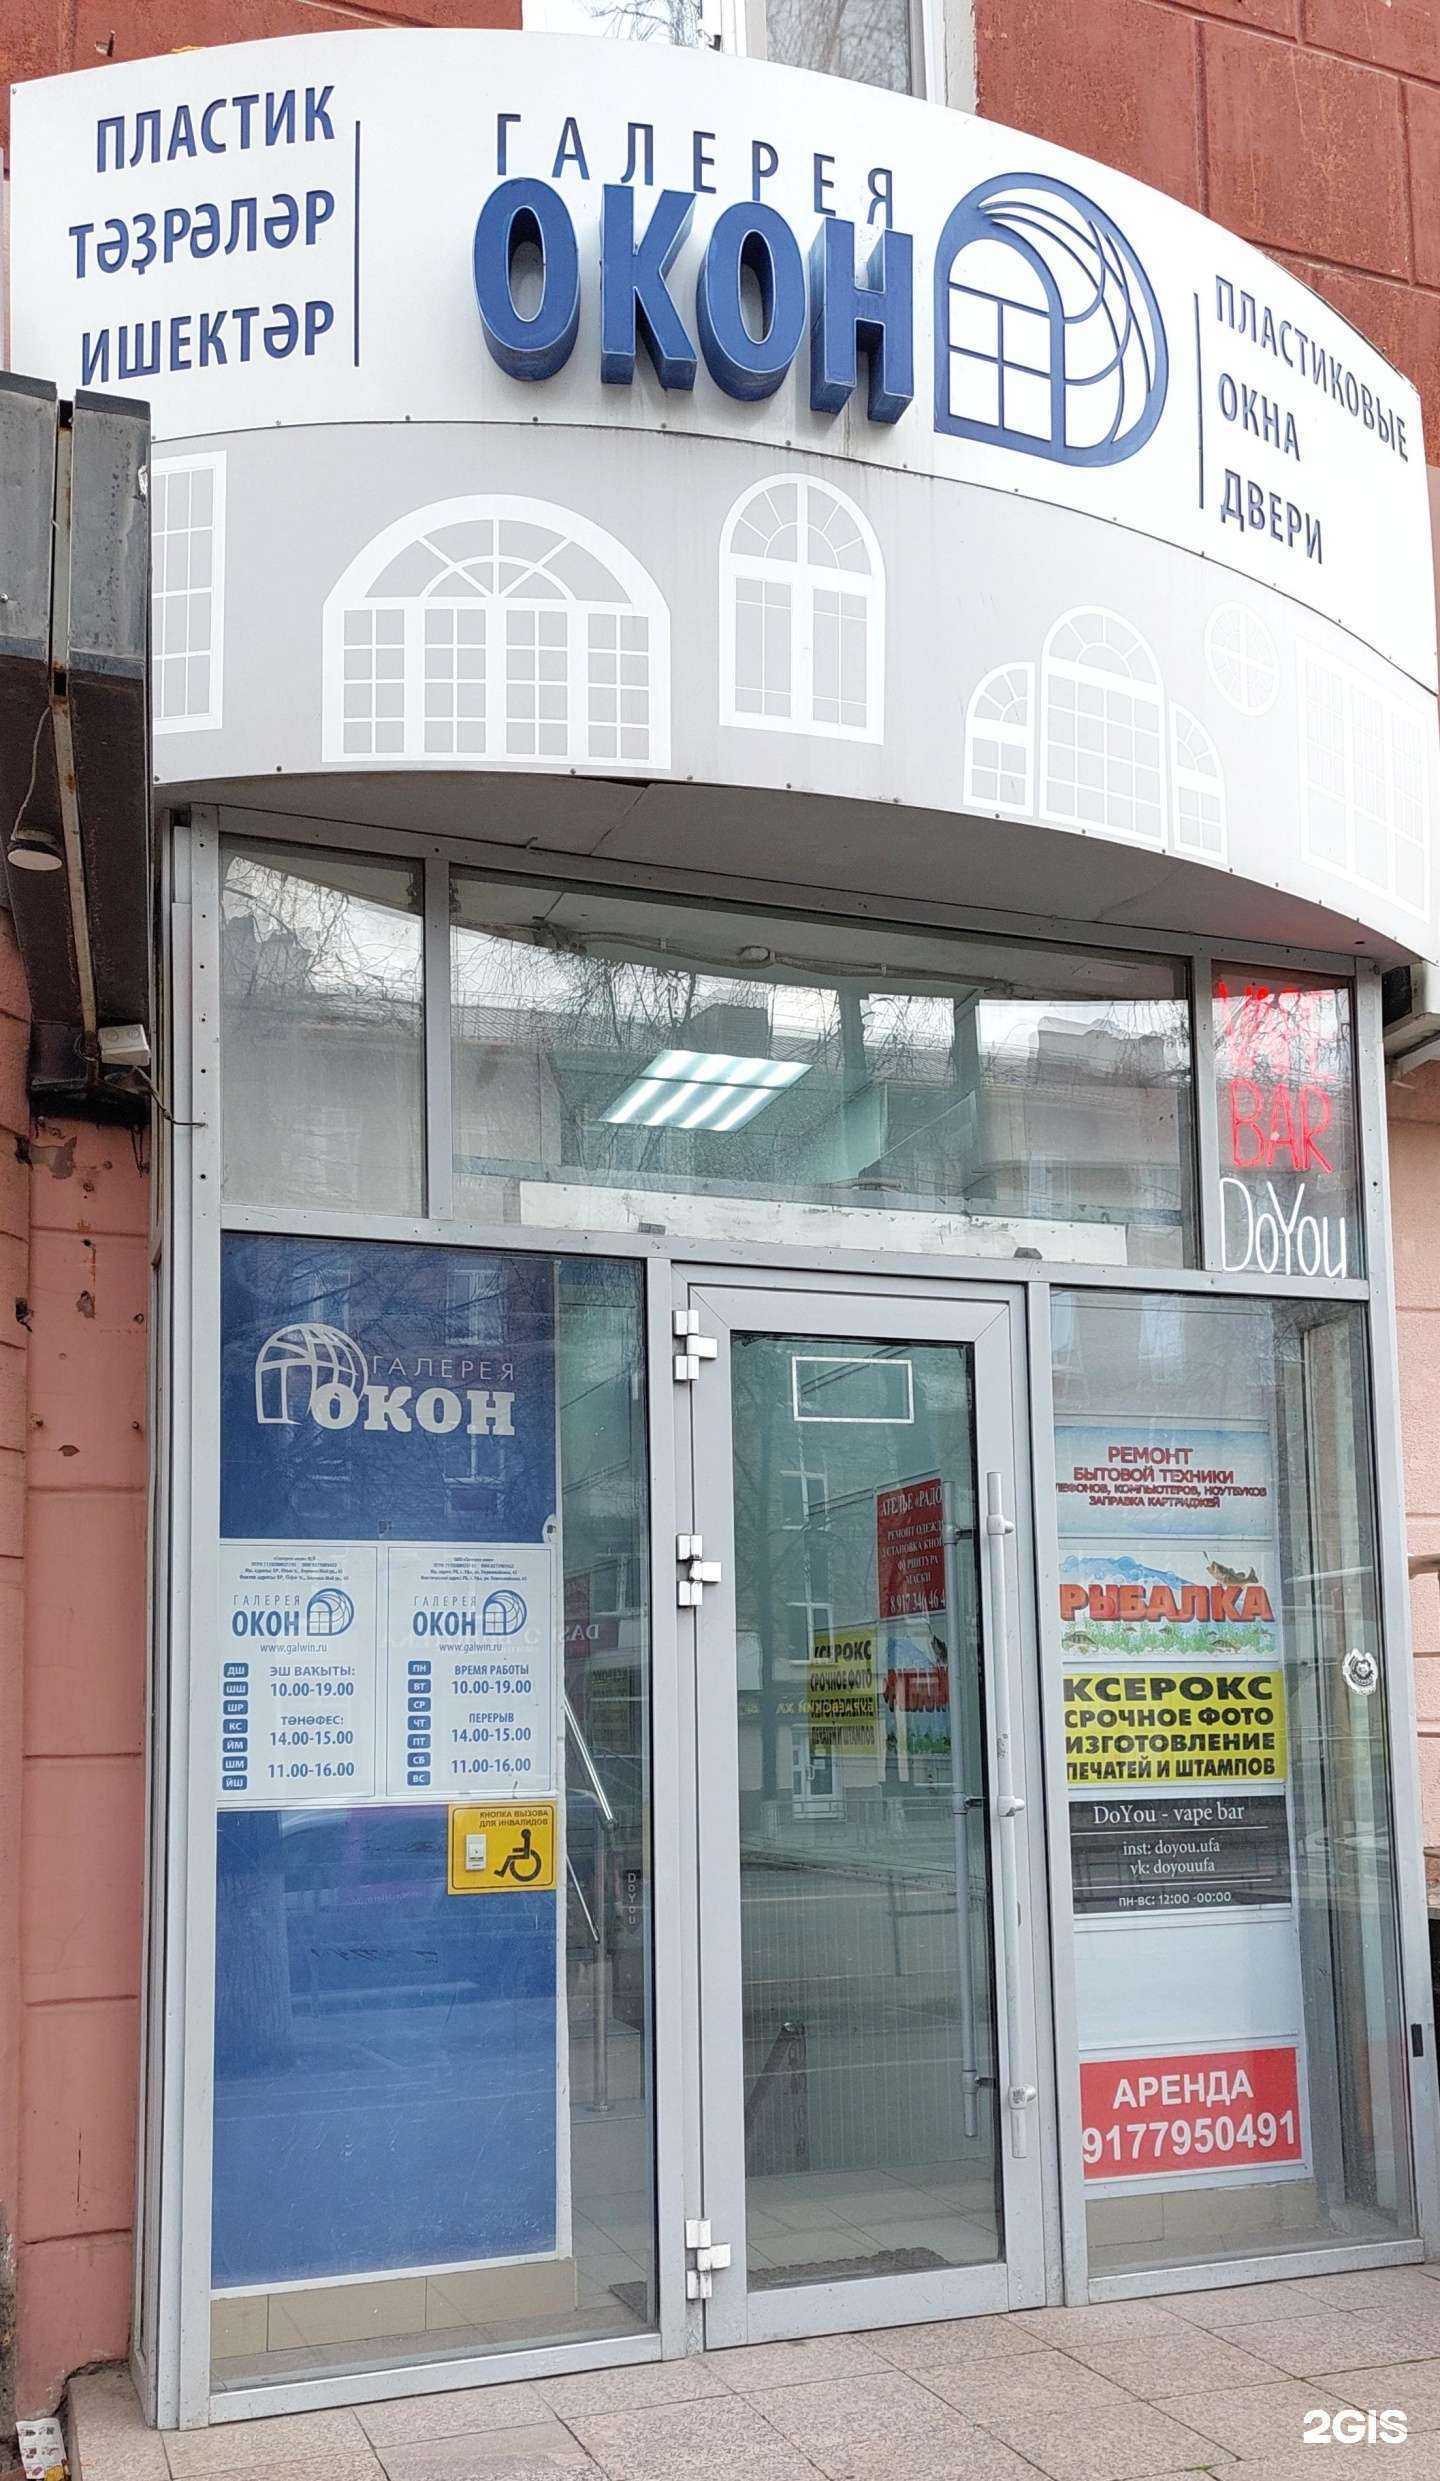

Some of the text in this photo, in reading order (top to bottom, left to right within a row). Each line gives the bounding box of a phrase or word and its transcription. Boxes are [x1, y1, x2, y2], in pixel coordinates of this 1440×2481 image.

[96, 85, 335, 173] ПЛАСТИК
[497, 113, 893, 229] ГАЛЕРЕЯ
[69, 189, 335, 279] ТӘҘРӘЛӘР
[472, 177, 914, 424] ОКОН
[82, 300, 335, 386] ИШЕКТӘР
[1215, 274, 1408, 463] ПЛАСТИКОВЫЕ
[1218, 372, 1301, 462] ОКНА
[1220, 468, 1322, 565] ДВЕРИ
[1229, 1078, 1334, 1174] BAR
[1219, 1177, 1347, 1279] DoYou
[373, 1355, 515, 1381] ГАЛЕРЕЯ
[310, 1381, 515, 1436] ОКОН
[1108, 1446, 1193, 1465] РЕМОНТ
[1073, 1466, 1234, 1484] БЫТОВОЙ ТЕХНИКИ
[1204, 1486, 1267, 1497] НОУТБУКОВ
[1088, 1496, 1221, 1509] ЗАПРАВКА КАРТРИДЖЕЙ
[233, 1595, 300, 1606] ГАЛЕРЕЯ
[414, 1595, 477, 1607] ГАЛЕРЕЯ
[1059, 1584, 1275, 1623] РЫБАЛКА
[232, 1611, 300, 1636] ОКОН
[412, 1611, 476, 1636] ОКОН
[260, 1643, 328, 1655] www.galwin.ru
[439, 1642, 503, 1654] www.galwin.ru
[269, 1666, 291, 1677] ЭШ
[413, 1664, 427, 1672] ПН
[454, 1664, 529, 1675] ВРЕМЯ РАБОТЫ
[226, 1684, 246, 1694] ШШ
[270, 1682, 354, 1696] 10.00-19.00
[413, 1682, 426, 1690] ВТ
[451, 1680, 532, 1694] 10.00-19.00
[1063, 1676, 1273, 1702] КСЕРОКС
[227, 1703, 244, 1712] ШР
[413, 1700, 426, 1709] СР
[413, 1719, 426, 1727] ЧТ
[468, 1713, 514, 1723] ПЕРЕРЫВ
[1064, 1707, 1274, 1728] СРОЧНОЕ ФОТО
[229, 1722, 242, 1731] КС
[451, 1727, 531, 1742] 14.00-15.00
[270, 1730, 354, 1746] 14.00-15.00
[413, 1738, 426, 1746] ПТ
[1065, 1732, 1275, 1754] ИЗГОТОВЛЕНИЕ
[225, 1759, 245, 1769] ШМ
[412, 1756, 425, 1764] СБ
[451, 1758, 532, 1773] 11.00-16.00
[1066, 1755, 1276, 1781] ПЕЧАТЕЙ И ШТАМПОВ
[268, 1762, 355, 1778] 11.00-16.00
[413, 1774, 425, 1783] ВС
[514, 1810, 549, 1818] ВЫЗОВА
[1093, 1804, 1157, 1824] DoYou
[1173, 1807, 1213, 1826] vape
[1216, 1802, 1245, 1821] bar
[480, 1819, 548, 1828] ДЛЯ ИНВАЛИДОВ
[1122, 1838, 1221, 1858] inst: doyou.ufa
[1130, 1857, 1216, 1878] vk: doyouufa
[1159, 1893, 1190, 1905] 12:00
[1112, 2069, 1254, 2110] АРЕНДА
[1082, 2110, 1295, 2164] 9177950491
